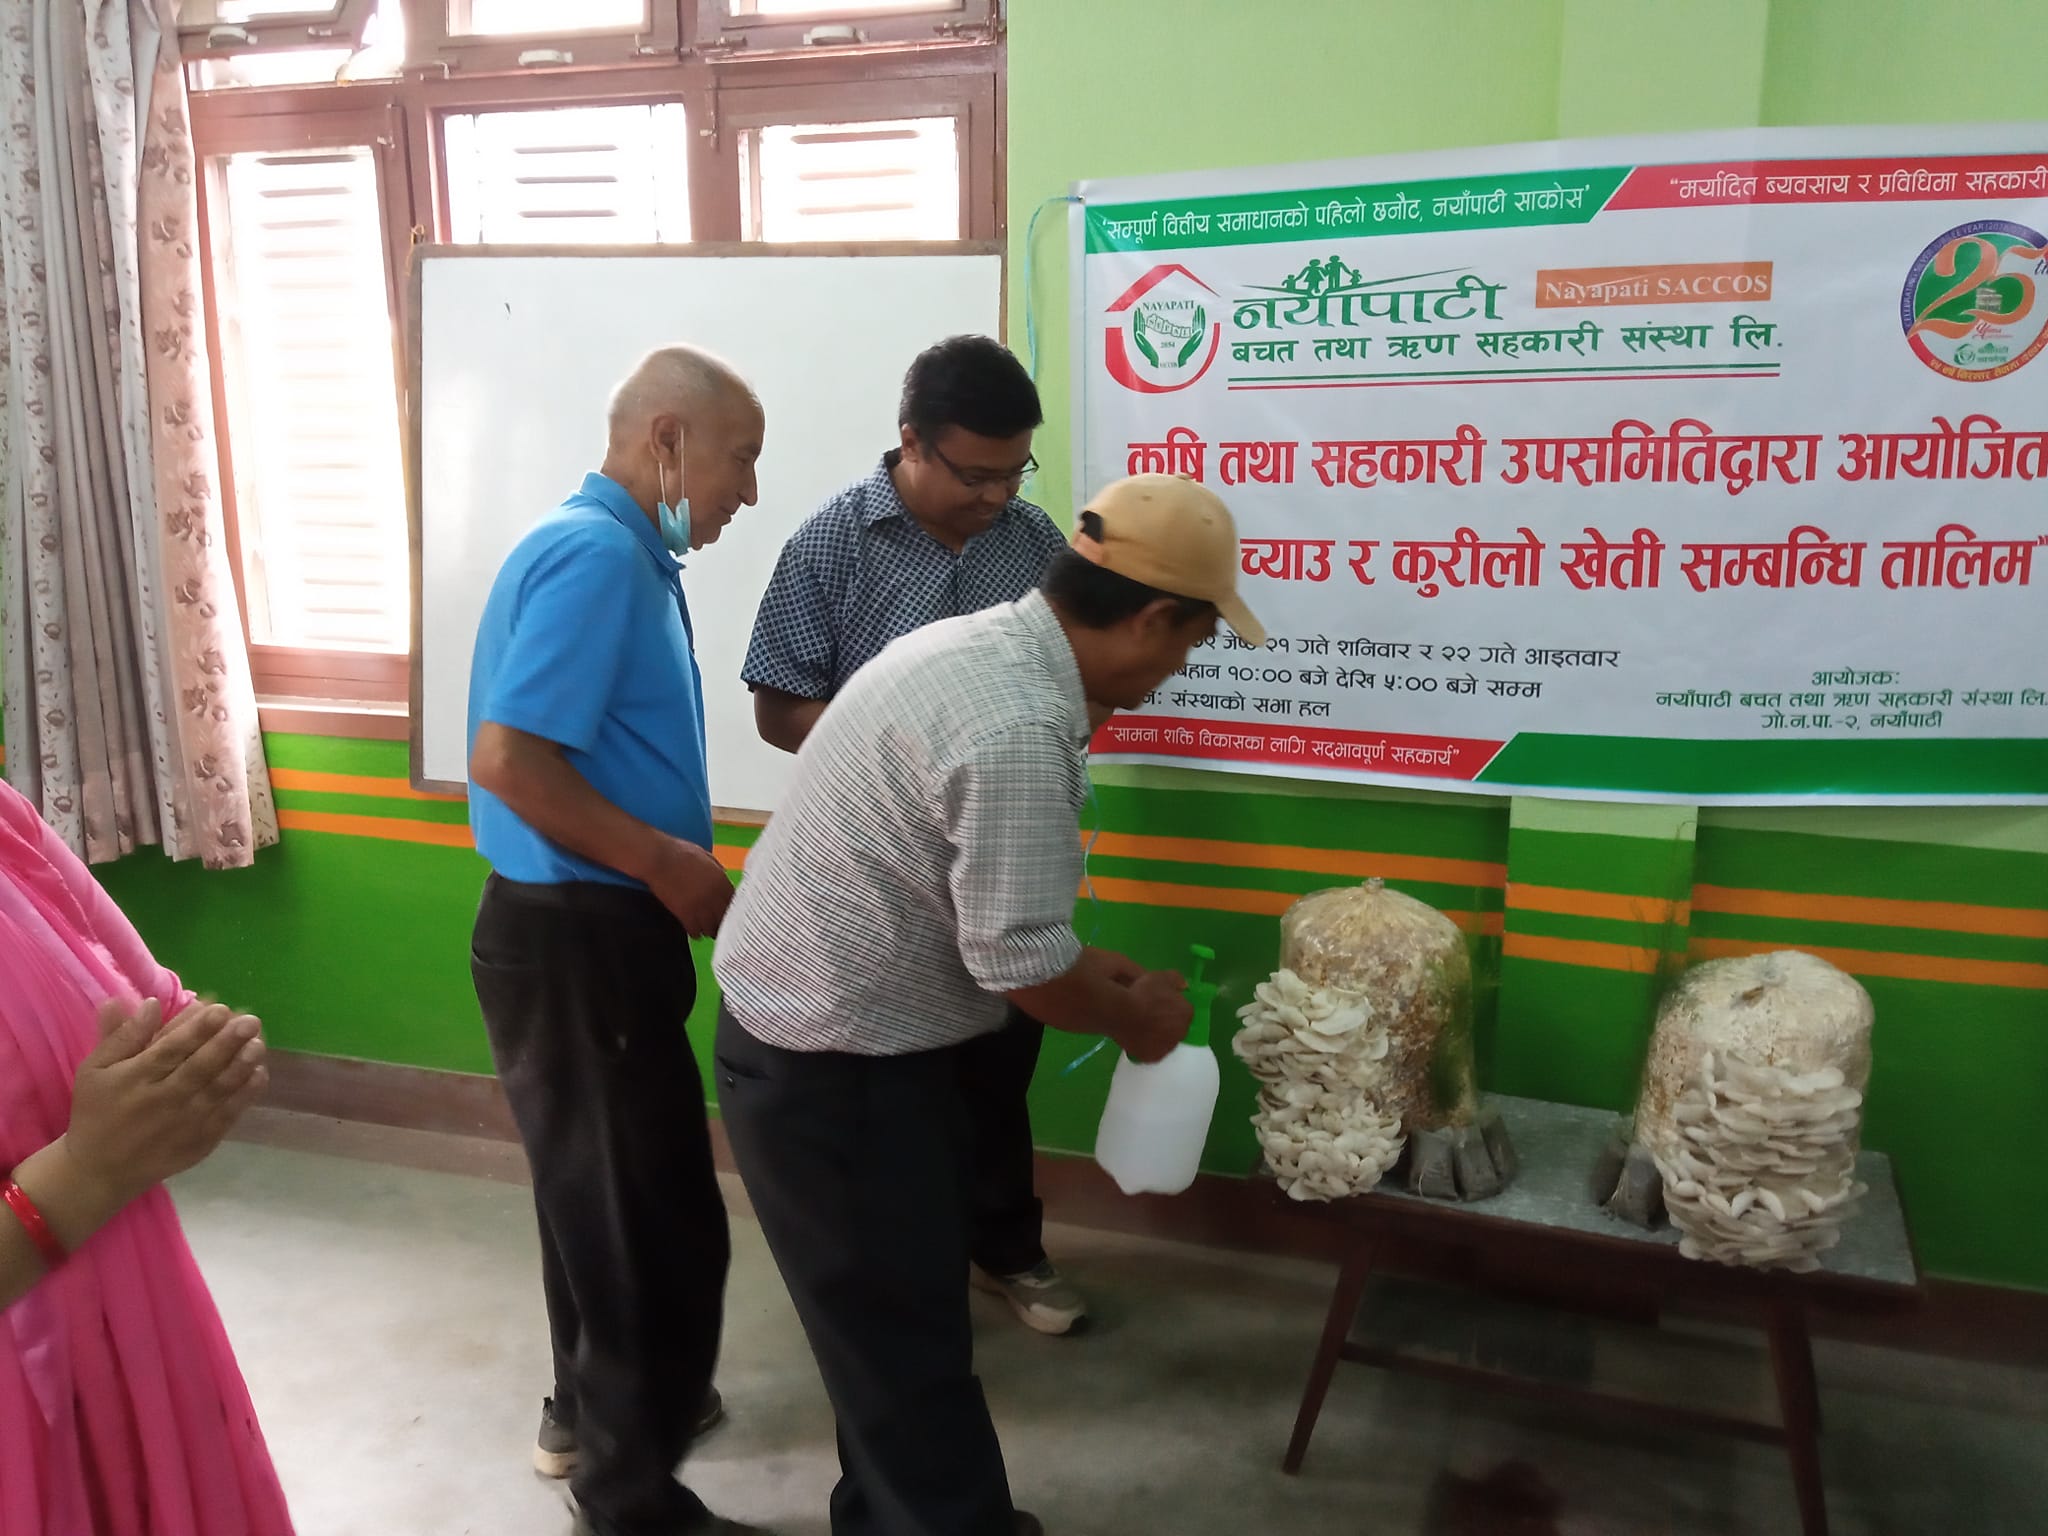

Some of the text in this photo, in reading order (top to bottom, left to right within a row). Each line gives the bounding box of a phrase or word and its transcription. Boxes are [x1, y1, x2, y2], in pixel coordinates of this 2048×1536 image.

[1857, 175, 1872, 194] र
[1879, 169, 1958, 196] प्रविधिमा
[1965, 165, 2048, 194] सहकारी
[1163, 211, 1211, 237] वित्तीय
[1216, 201, 1310, 233] समाधानको
[1315, 196, 1366, 228] पहिलो
[1373, 192, 1423, 223] छनौट,
[1432, 188, 1507, 217] नयाँपाटी
[1142, 300, 1194, 311] NAYAPATI
[1545, 274, 1768, 304] Nayapati SACCOS
[1231, 314, 1783, 364] बचत तथा ऋण सहकारी संस्था लि.
[1218, 440, 1299, 487] तथा
[1311, 423, 1488, 489] सहकारी
[1500, 417, 1823, 496] उपसमितिद्वारा
[1837, 414, 2048, 482] आयोजित
[1240, 538, 1337, 582] च्याउ
[1348, 540, 1381, 586] र
[1392, 526, 1546, 599] कुरीलो
[1560, 527, 1666, 591] खेती
[1680, 525, 1867, 593] सम्बन्धि
[1265, 637, 1290, 654] २१
[1296, 633, 1330, 656] गते
[1336, 637, 1412, 660] शनिवार
[1418, 644, 1434, 660] र
[1442, 646, 1471, 662] २२
[1479, 641, 1517, 665] गते
[1524, 648, 1621, 668] आइतवार
[1227, 664, 1293, 684] १०:००
[1298, 665, 1329, 687] बजे
[1335, 666, 1376, 689] देखि
[1383, 674, 1438, 692] ५:००
[1446, 672, 1480, 695] बजे
[1486, 679, 1543, 699] सम्म
[1739, 692, 1783, 708] बचत
[1789, 692, 1826, 708] तथा
[1833, 692, 1870, 708] ऋण
[1878, 688, 1953, 708] सहकारी
[1961, 688, 2015, 706] संस्था
[1170, 689, 1247, 712] संस्थाको
[1252, 697, 1293, 715] सभा
[1298, 700, 1332, 717] हल
[1164, 727, 1194, 745] शक्ति
[1199, 729, 1265, 751] विकासका
[1270, 735, 1305, 755] लागि
